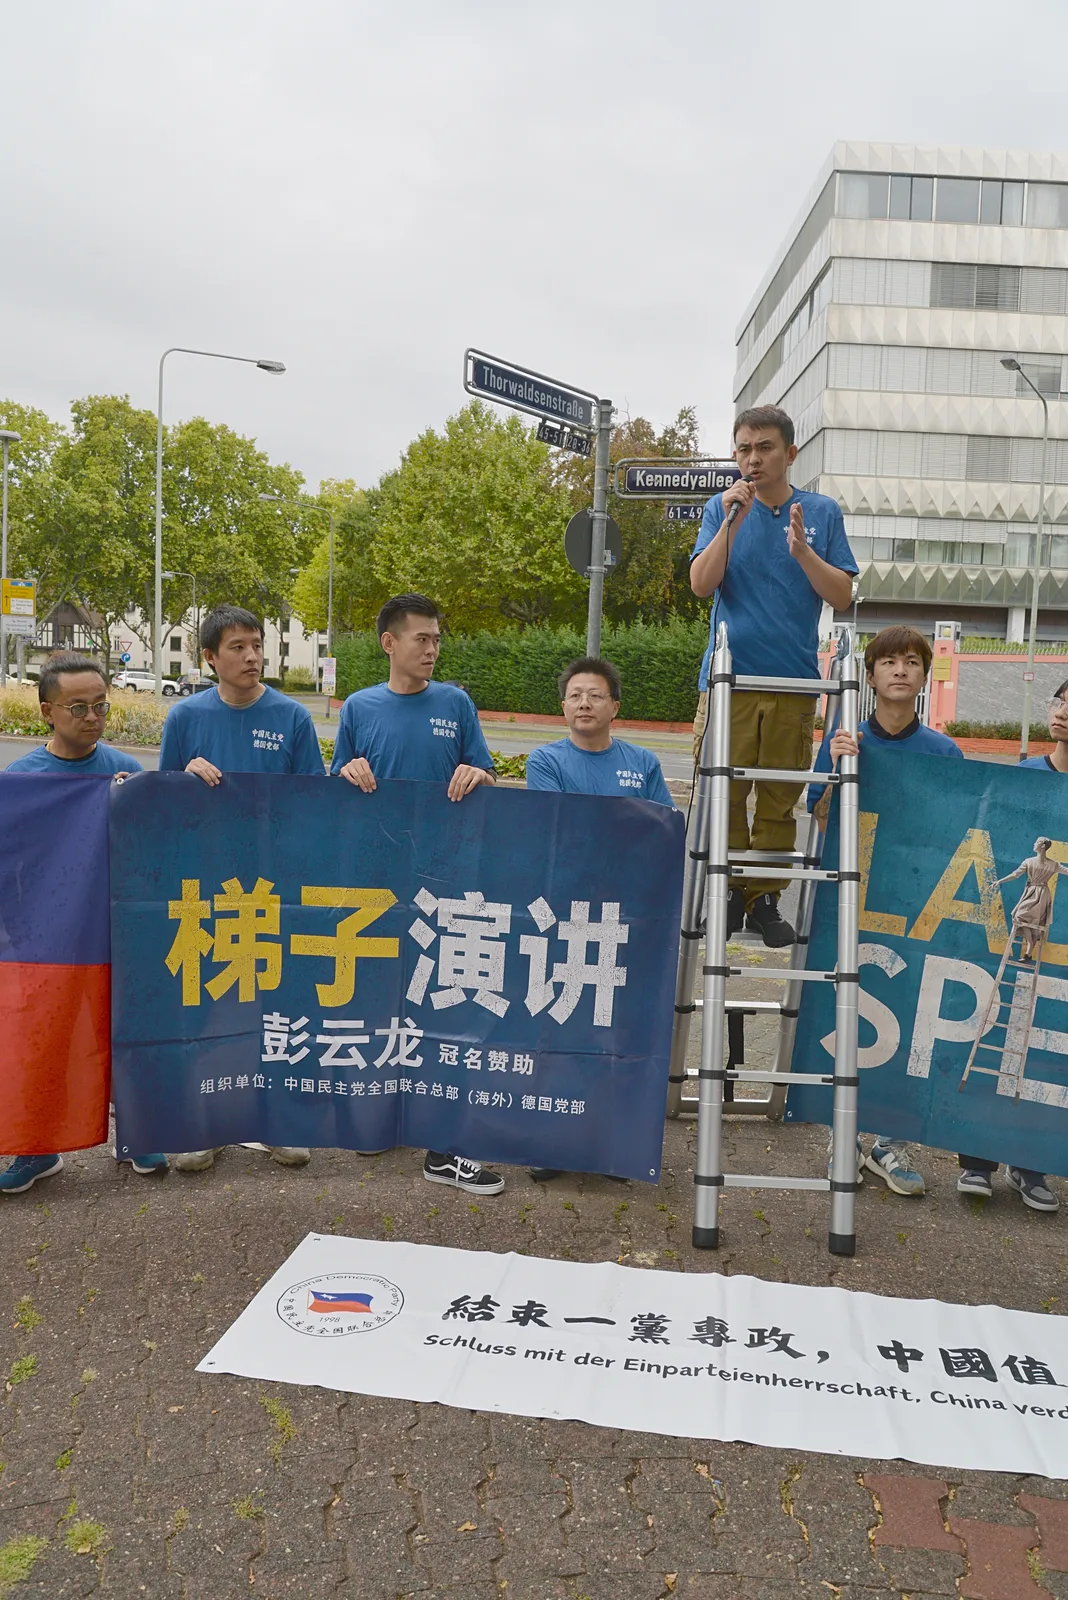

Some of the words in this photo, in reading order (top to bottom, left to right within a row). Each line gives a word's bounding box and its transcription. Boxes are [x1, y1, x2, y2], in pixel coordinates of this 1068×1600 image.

[483, 365, 584, 419] Thorwaldsenstraße
[539, 426, 563, 446] 45-51
[567, 435, 591, 454] 28-36
[636, 470, 734, 490] Kennedyallee
[668, 506, 703, 519] 61-49
[164, 876, 629, 1027] 梯子演讲
[261, 1012, 424, 1070] 彭云龙
[439, 1043, 534, 1076] 冠名赞助
[290, 1278, 322, 1295] China
[326, 1275, 390, 1289] Democratic
[389, 1287, 400, 1307] Party
[423, 1334, 517, 1356] Schluss
[524, 1348, 567, 1362] mit
[573, 1353, 616, 1368] der
[623, 1357, 921, 1404] Einparteienherrschaft,
[930, 1390, 1008, 1411] China
